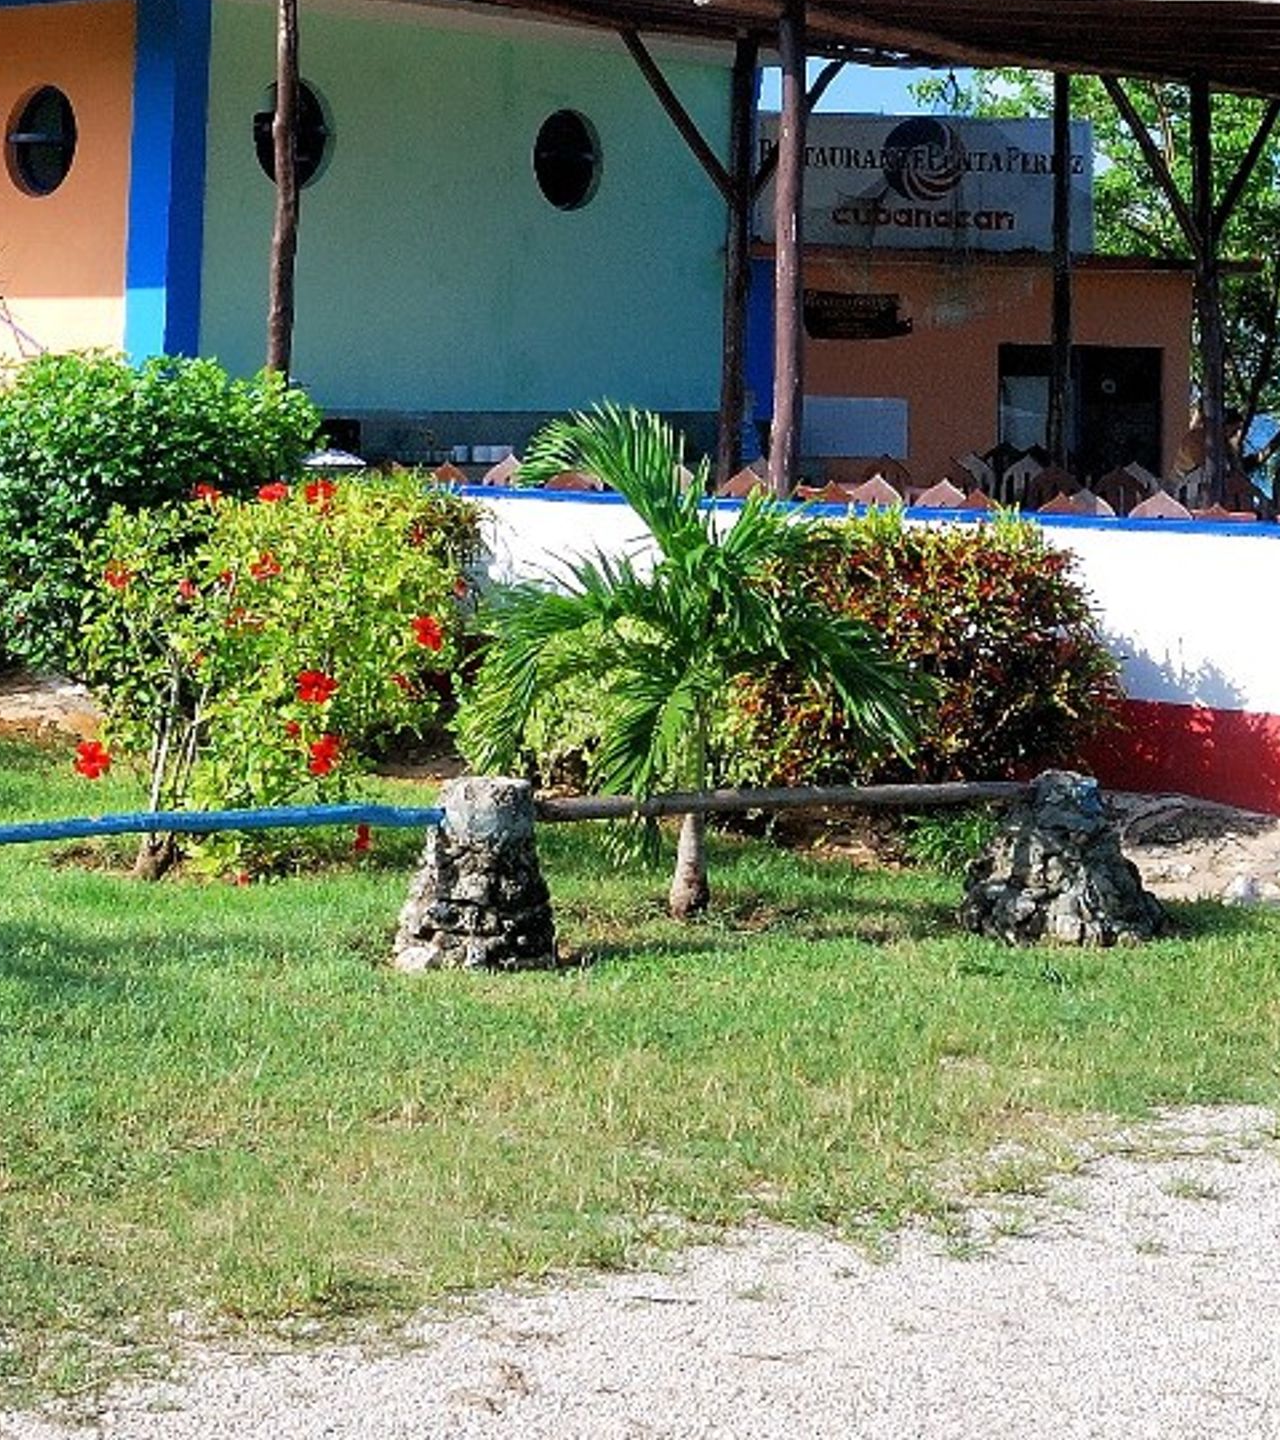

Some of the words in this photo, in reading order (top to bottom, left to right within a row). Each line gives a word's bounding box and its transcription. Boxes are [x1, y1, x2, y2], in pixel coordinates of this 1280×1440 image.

[759, 139, 926, 170] RTAURANTE
[1006, 147, 1084, 174] PERZ
[831, 203, 1016, 230] cubanacan
